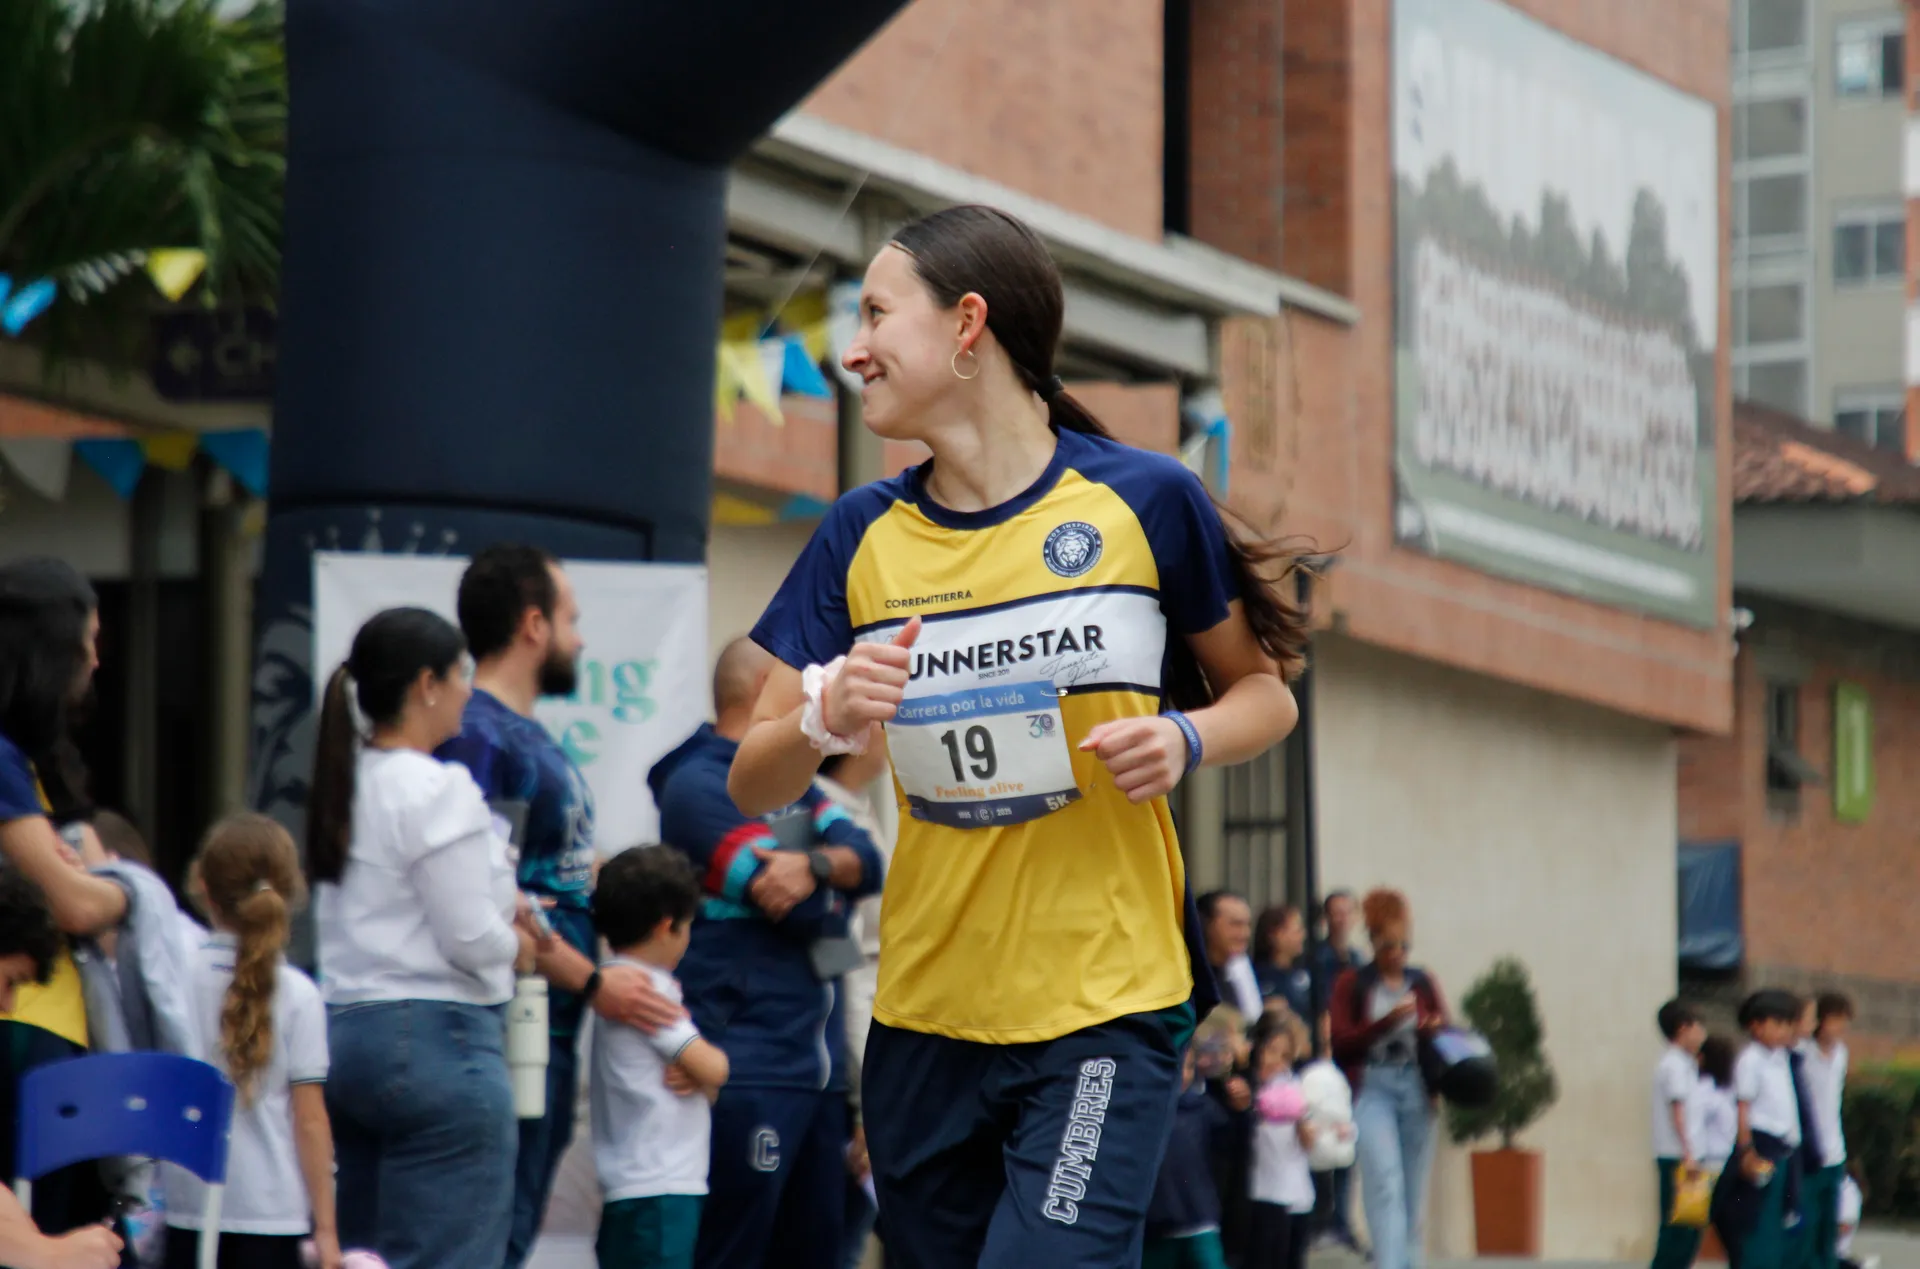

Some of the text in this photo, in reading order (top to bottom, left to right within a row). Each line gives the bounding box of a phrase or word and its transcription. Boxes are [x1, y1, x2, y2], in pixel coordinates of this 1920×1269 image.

[884, 589, 973, 609] CORREMITIERRA
[907, 624, 1106, 680] UNNERSTAR
[978, 671, 996, 680] SINCE
[898, 691, 1026, 719] Carrera por la vida
[941, 725, 998, 783] 19
[935, 780, 1024, 799] Feeling alive
[1046, 794, 1070, 811] 5K
[752, 1127, 780, 1172] C
[1042, 1056, 1117, 1224] CUMBRES
